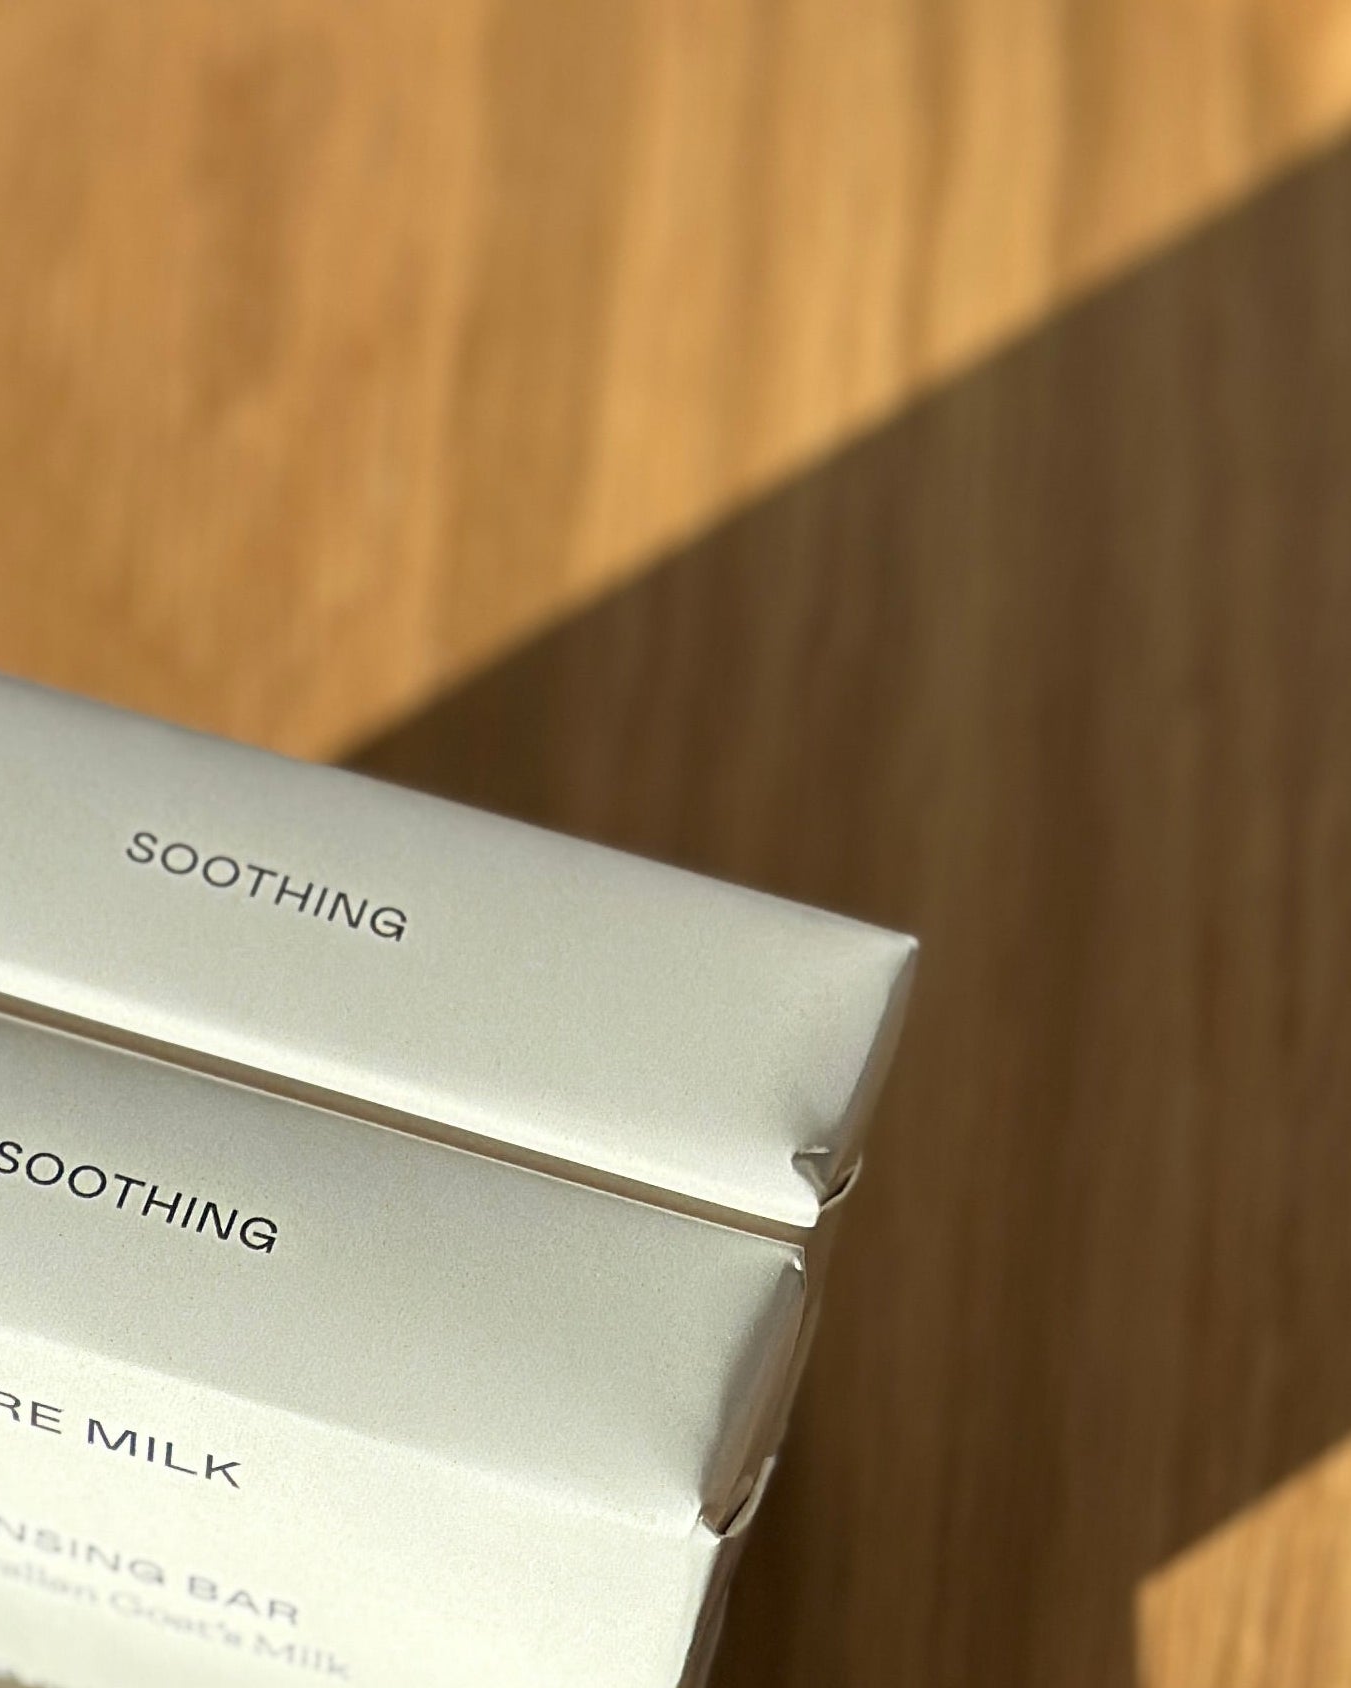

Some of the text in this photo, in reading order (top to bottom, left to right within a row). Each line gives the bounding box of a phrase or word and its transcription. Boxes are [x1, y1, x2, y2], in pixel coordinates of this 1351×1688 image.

[125, 830, 408, 943] SOOTHING
[86, 1417, 242, 1490] MILK
[187, 1574, 301, 1627] BAR
[252, 1632, 351, 1681] Milk
